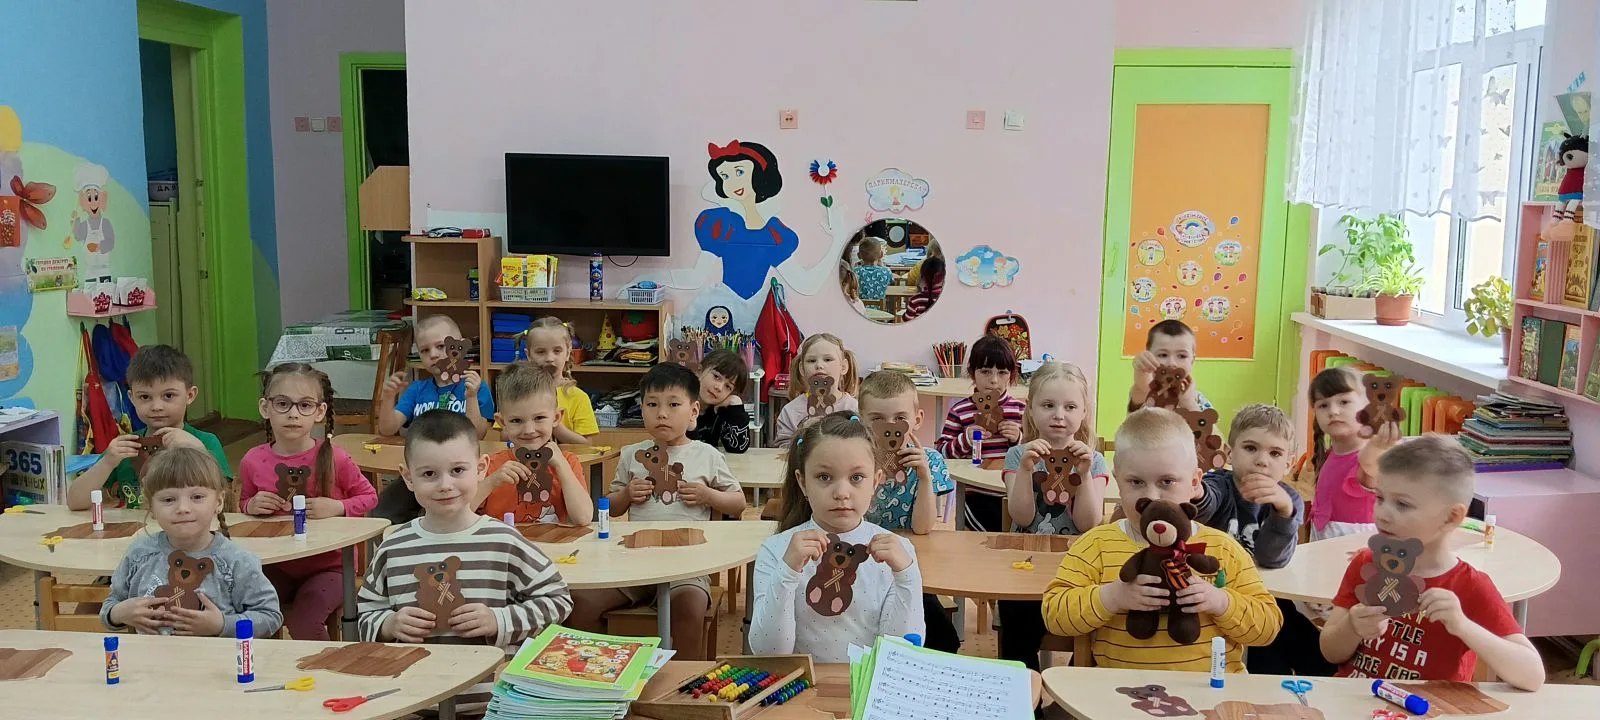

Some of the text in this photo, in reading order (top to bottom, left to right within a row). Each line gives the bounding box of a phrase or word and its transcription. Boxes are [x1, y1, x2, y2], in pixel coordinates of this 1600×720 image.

[448, 399, 467, 413] TOU
[7, 449, 42, 475] 365
[1352, 653, 1381, 675] ACE
[1389, 641, 1409, 661] IS
[1413, 649, 1428, 667] A
